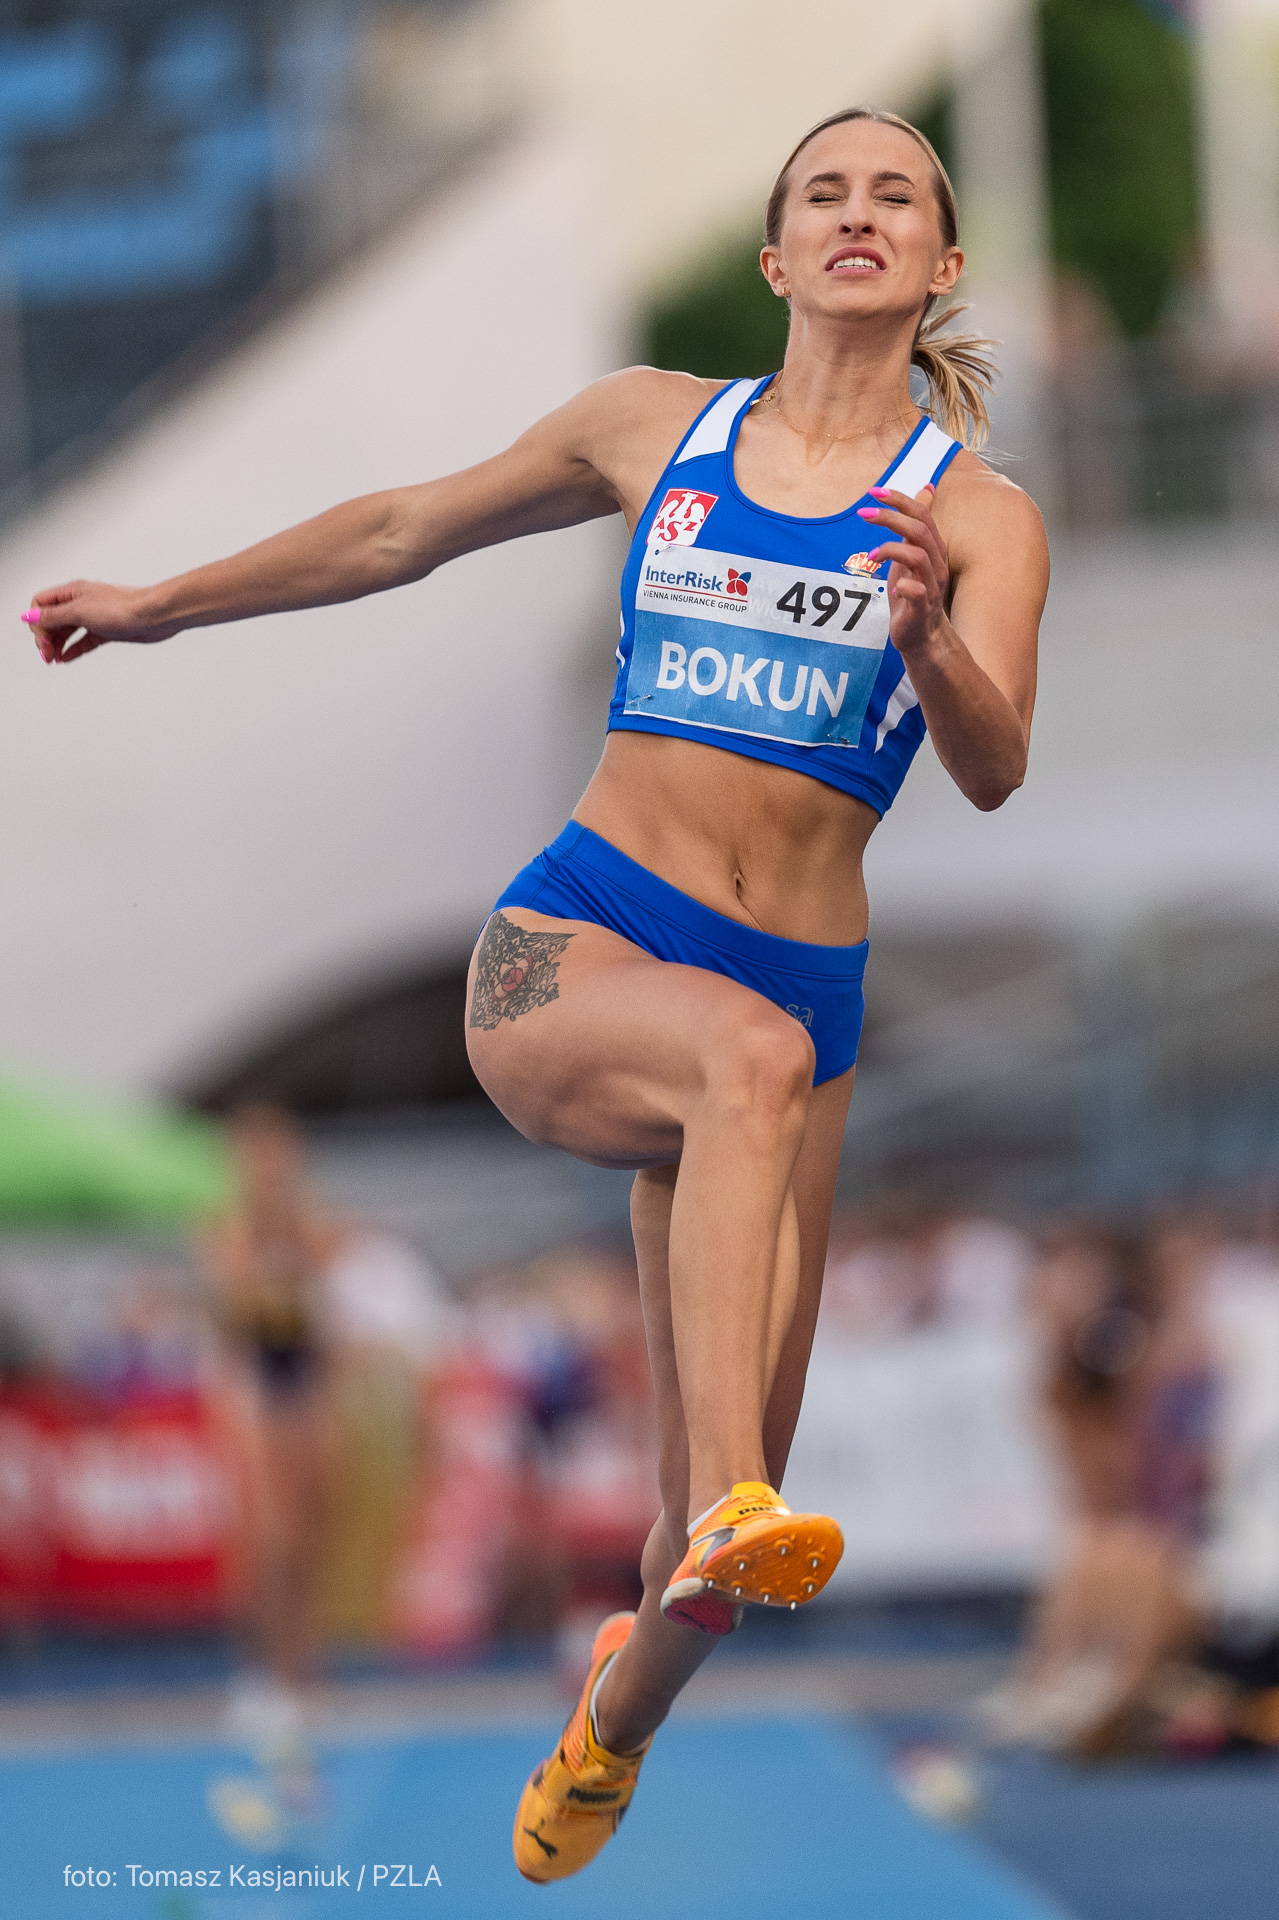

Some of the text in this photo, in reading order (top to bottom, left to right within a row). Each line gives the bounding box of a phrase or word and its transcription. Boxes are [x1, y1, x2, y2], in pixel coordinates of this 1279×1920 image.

[645, 565, 723, 592] InterRisk
[643, 589, 747, 613] VIENNA INSURANCE GROUP
[776, 581, 871, 632] 497
[656, 640, 849, 718] BOKUN
